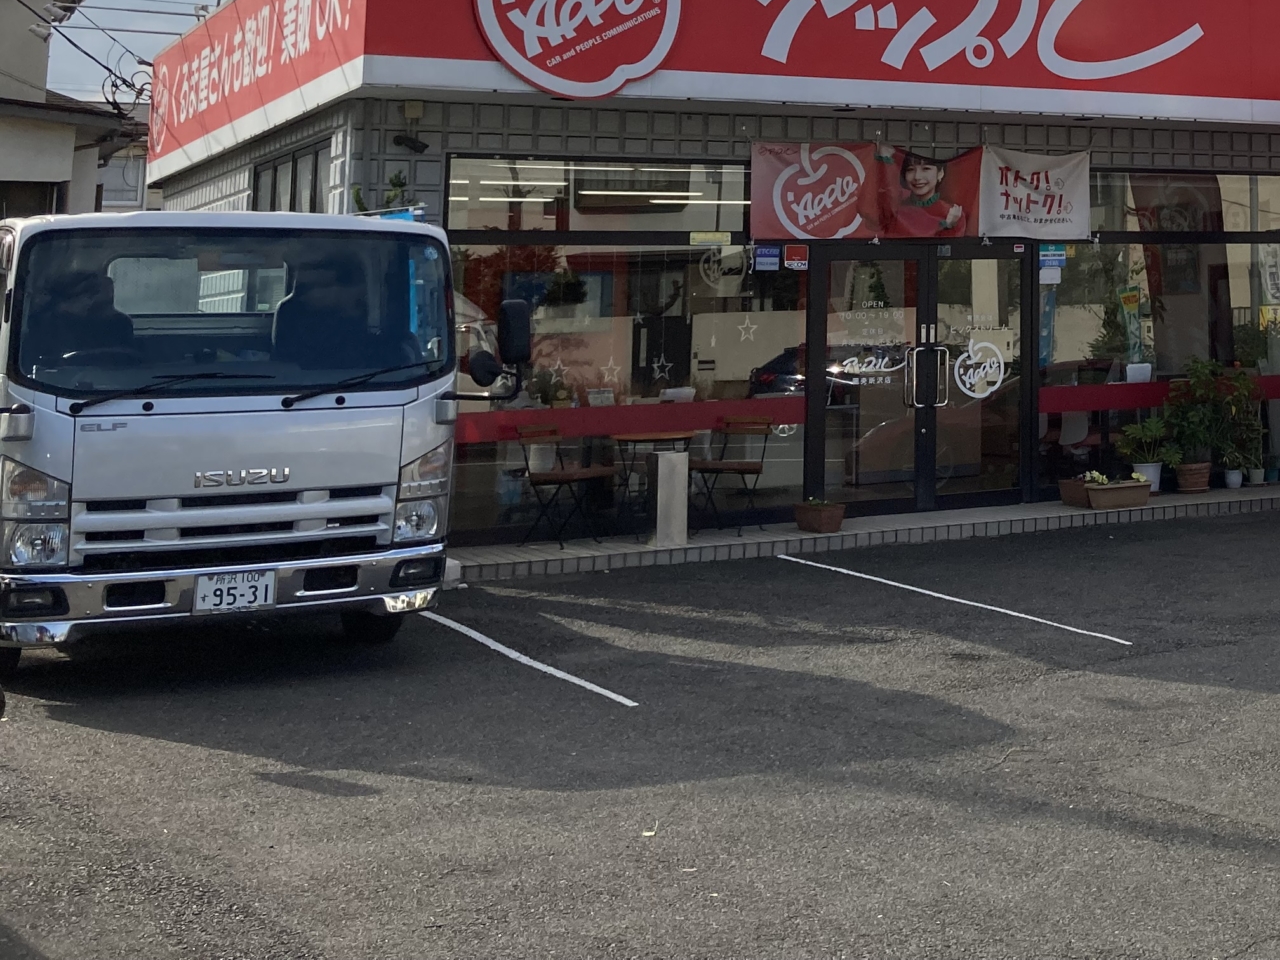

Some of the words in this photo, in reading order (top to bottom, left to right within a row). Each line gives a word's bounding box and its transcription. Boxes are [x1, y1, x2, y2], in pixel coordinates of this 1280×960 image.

[546, 54, 562, 68] CAR
[562, 48, 576, 60] and
[575, 35, 603, 54] PEOPLE
[602, 6, 662, 40] COMMUNICATIONS
[791, 175, 858, 226] Apple
[862, 300, 884, 309] OPEN
[80, 422, 128, 432] ELF
[194, 466, 290, 489] ISUZU
[212, 583, 269, 607] 95-31
